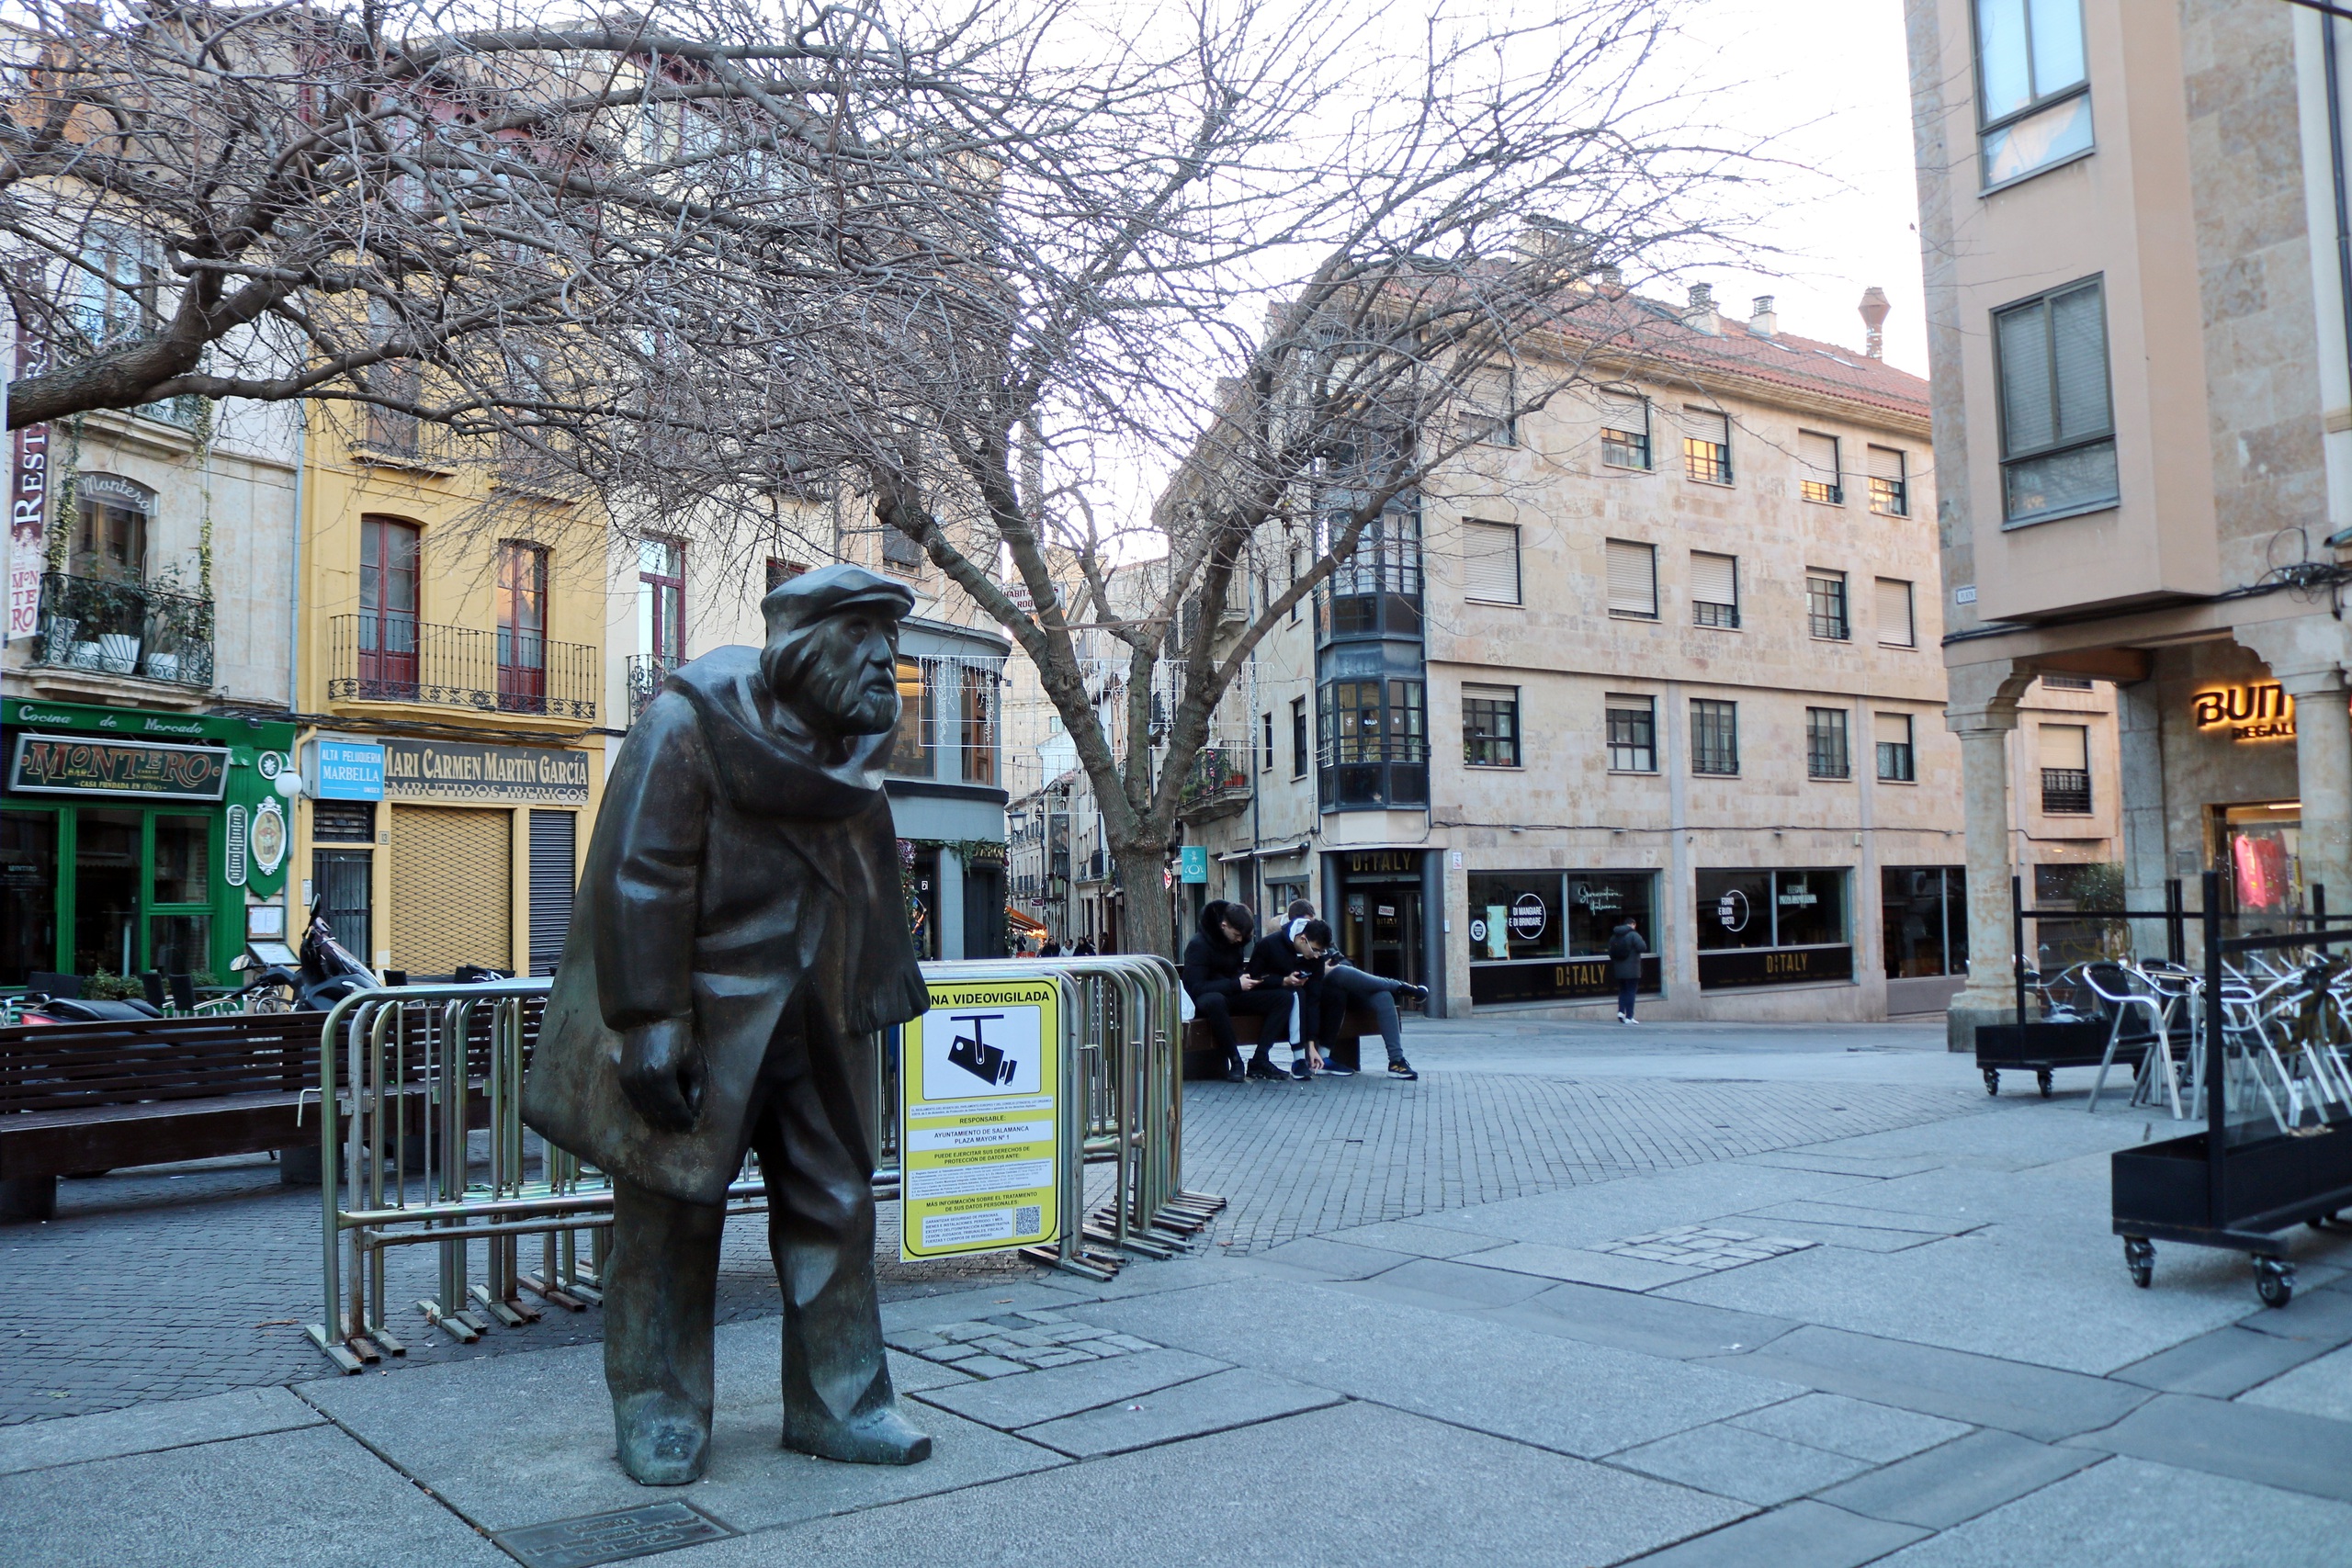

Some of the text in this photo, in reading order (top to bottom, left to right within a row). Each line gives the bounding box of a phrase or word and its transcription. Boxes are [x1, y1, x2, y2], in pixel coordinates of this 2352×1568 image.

[78, 474, 150, 510] Montero
[18, 705, 204, 734] Cocina de Mercado
[2231, 722, 2296, 740] REGAL
[322, 749, 382, 764] ALTA PELUQUERIA
[27, 742, 212, 789] MONTERO
[322, 765, 379, 783] MARBELLA
[423, 748, 481, 781] CARMEN
[484, 750, 537, 784] MARTÍN
[538, 754, 588, 785] GARCÍA
[80, 780, 97, 788] CASA
[98, 781, 130, 790] FUNDADA
[506, 785, 589, 802] IBERICOS
[931, 990, 1050, 1006] NA VIDEOVIGILADA
[960, 1115, 1005, 1123] RESPONSABLE:
[934, 1130, 980, 1138] AYUNTAMIENTO
[992, 1125, 1029, 1134] SALAMANCA
[939, 1197, 975, 1205] INFORMACIÓN
